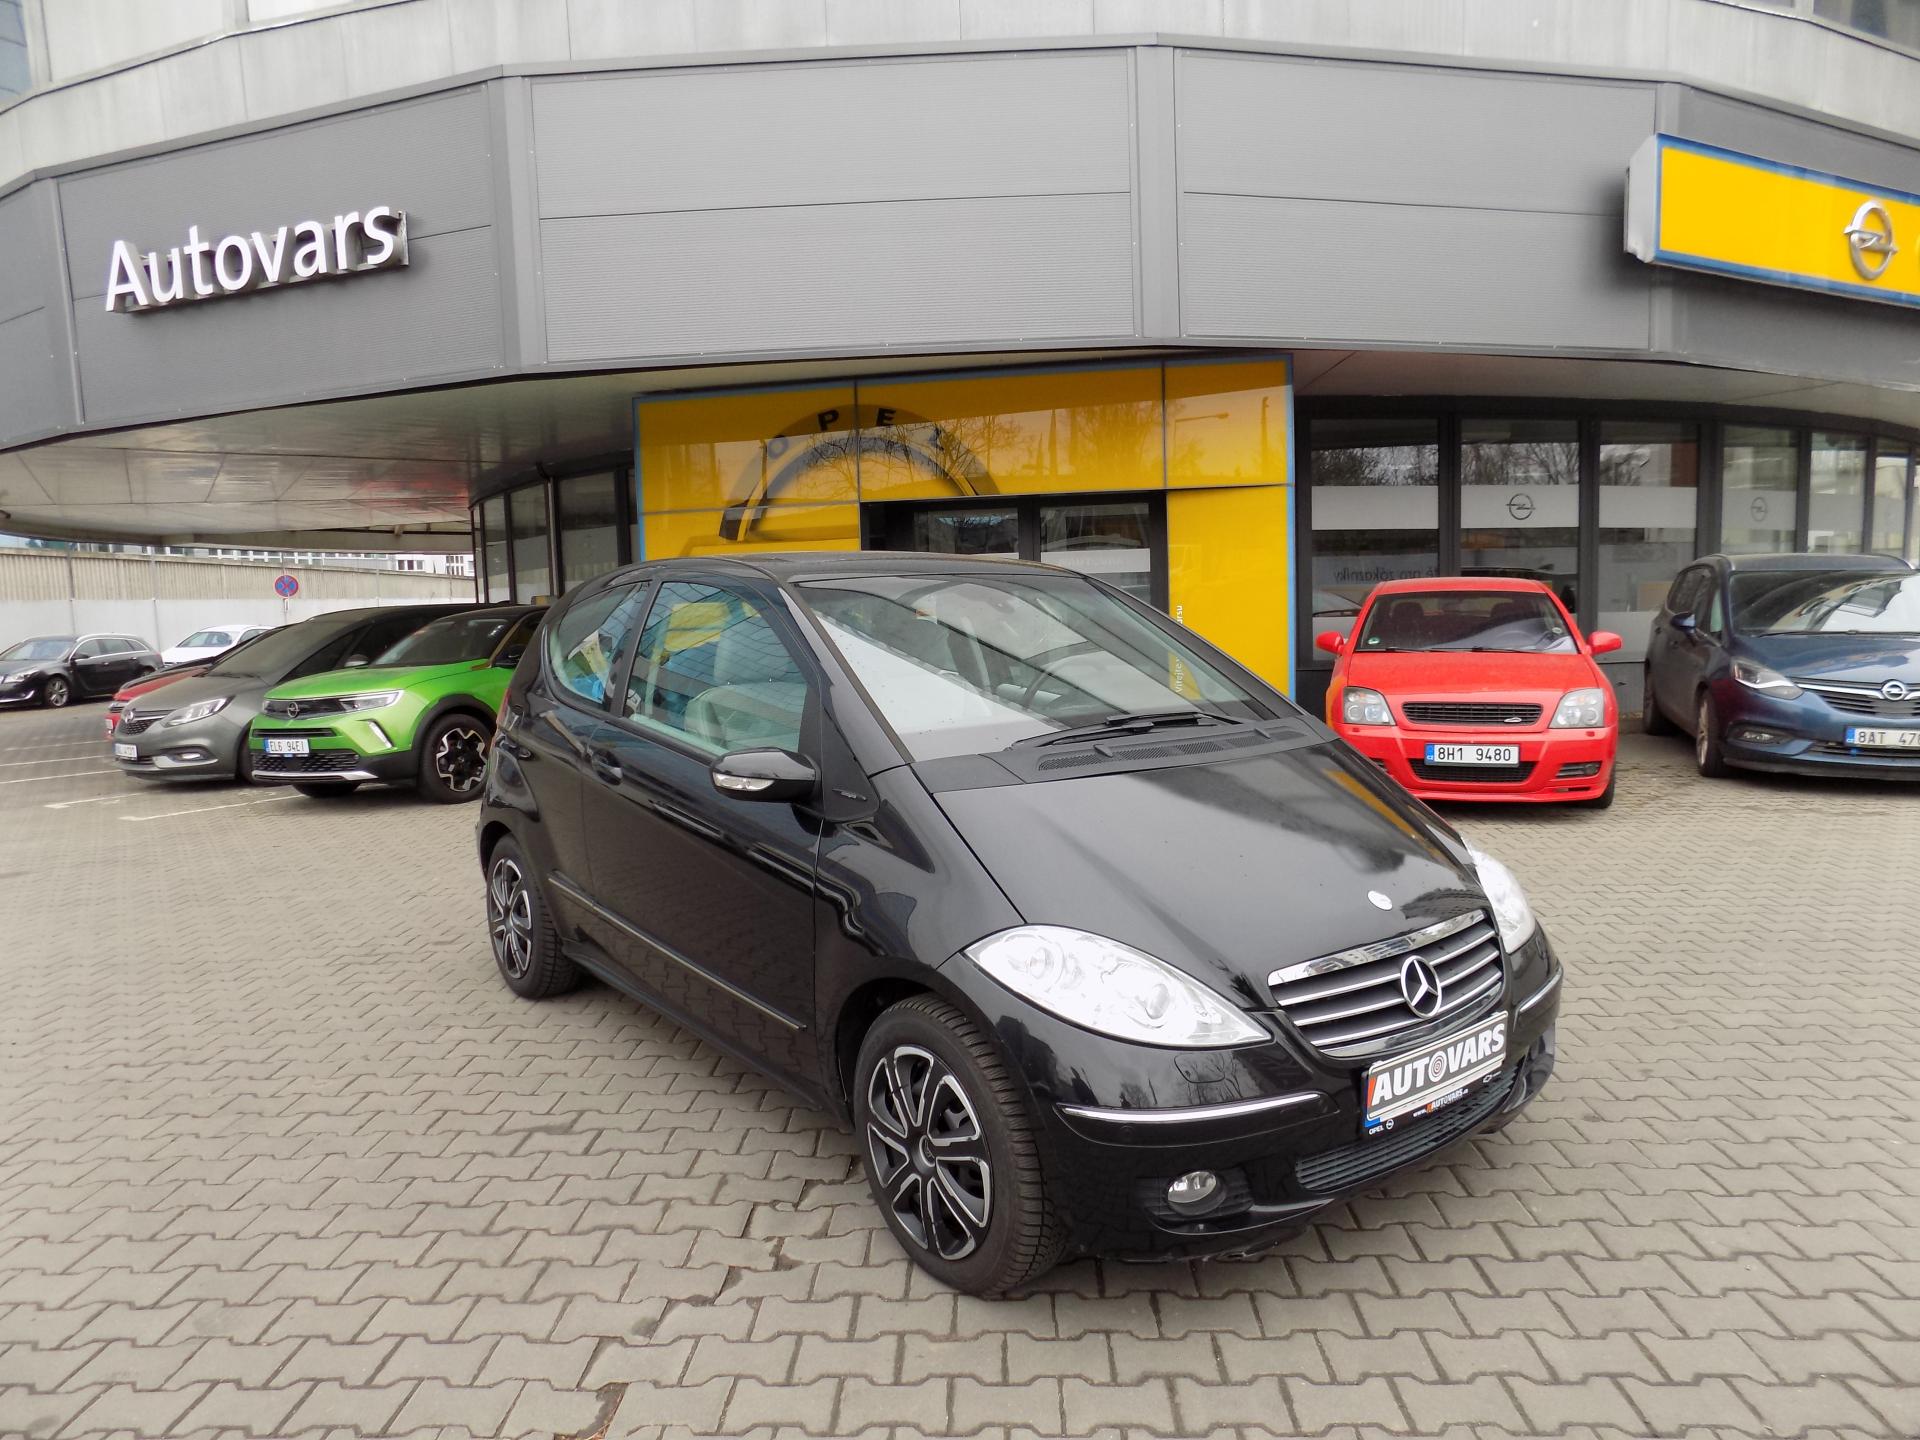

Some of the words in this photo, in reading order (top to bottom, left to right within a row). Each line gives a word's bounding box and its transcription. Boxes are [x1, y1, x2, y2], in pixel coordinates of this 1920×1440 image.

[106, 206, 394, 312] Autovars
[1858, 731, 1886, 744] 8AT
[270, 741, 282, 752] EL6
[1438, 747, 1463, 760] 8H1
[1476, 748, 1511, 761] 9480
[1371, 1022, 1505, 1106] AUTOVARS
